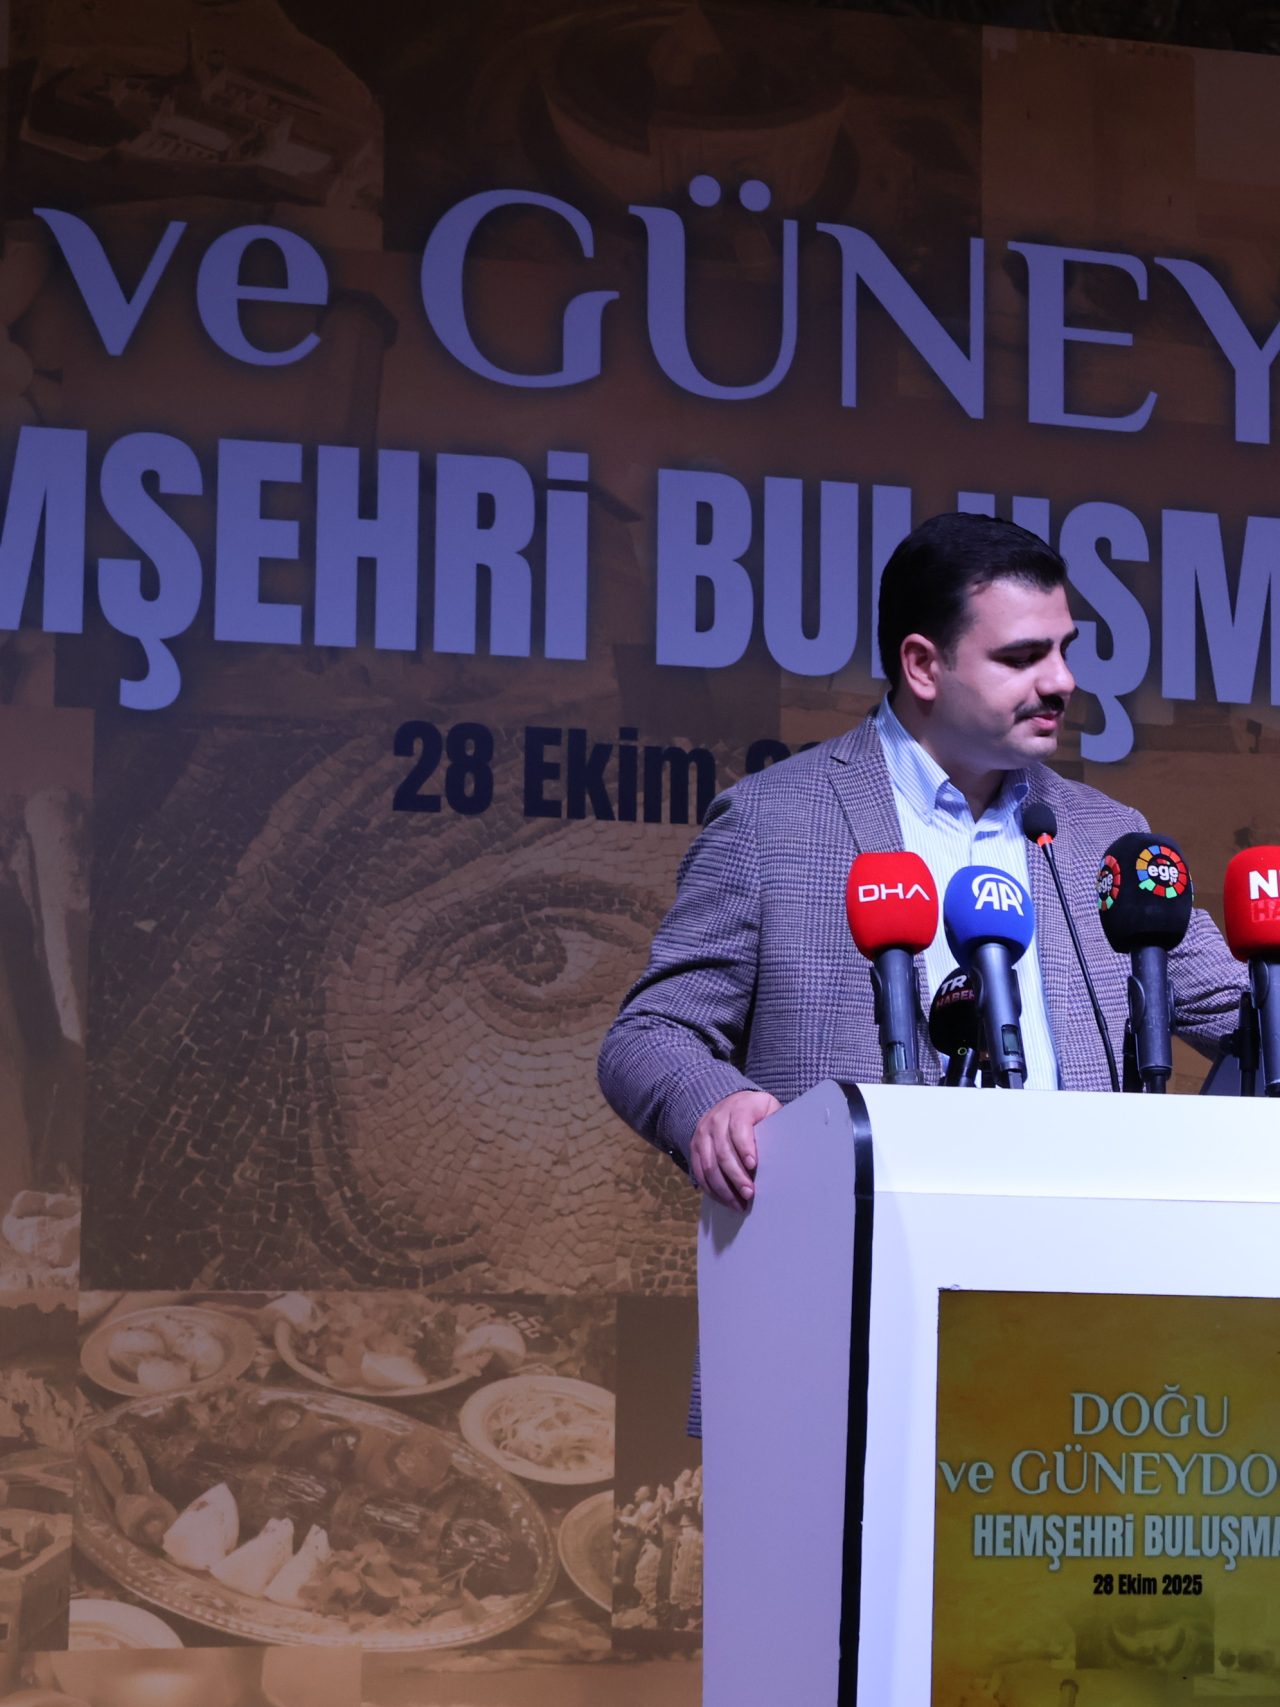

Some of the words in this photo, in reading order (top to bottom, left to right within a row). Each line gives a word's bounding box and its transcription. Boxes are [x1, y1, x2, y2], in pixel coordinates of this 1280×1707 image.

[33, 207, 329, 366] ve
[392, 720, 495, 815] 28
[523, 726, 716, 825] Ekim
[1147, 865, 1179, 881] ege
[858, 882, 931, 903] DHA
[973, 879, 1024, 917] AA
[1071, 1384, 1229, 1437] DOĞU
[938, 1461, 995, 1494] ve
[1093, 1574, 1114, 1596] 28
[1118, 1573, 1158, 1596] Ekim
[1162, 1574, 1203, 1596] 2025
